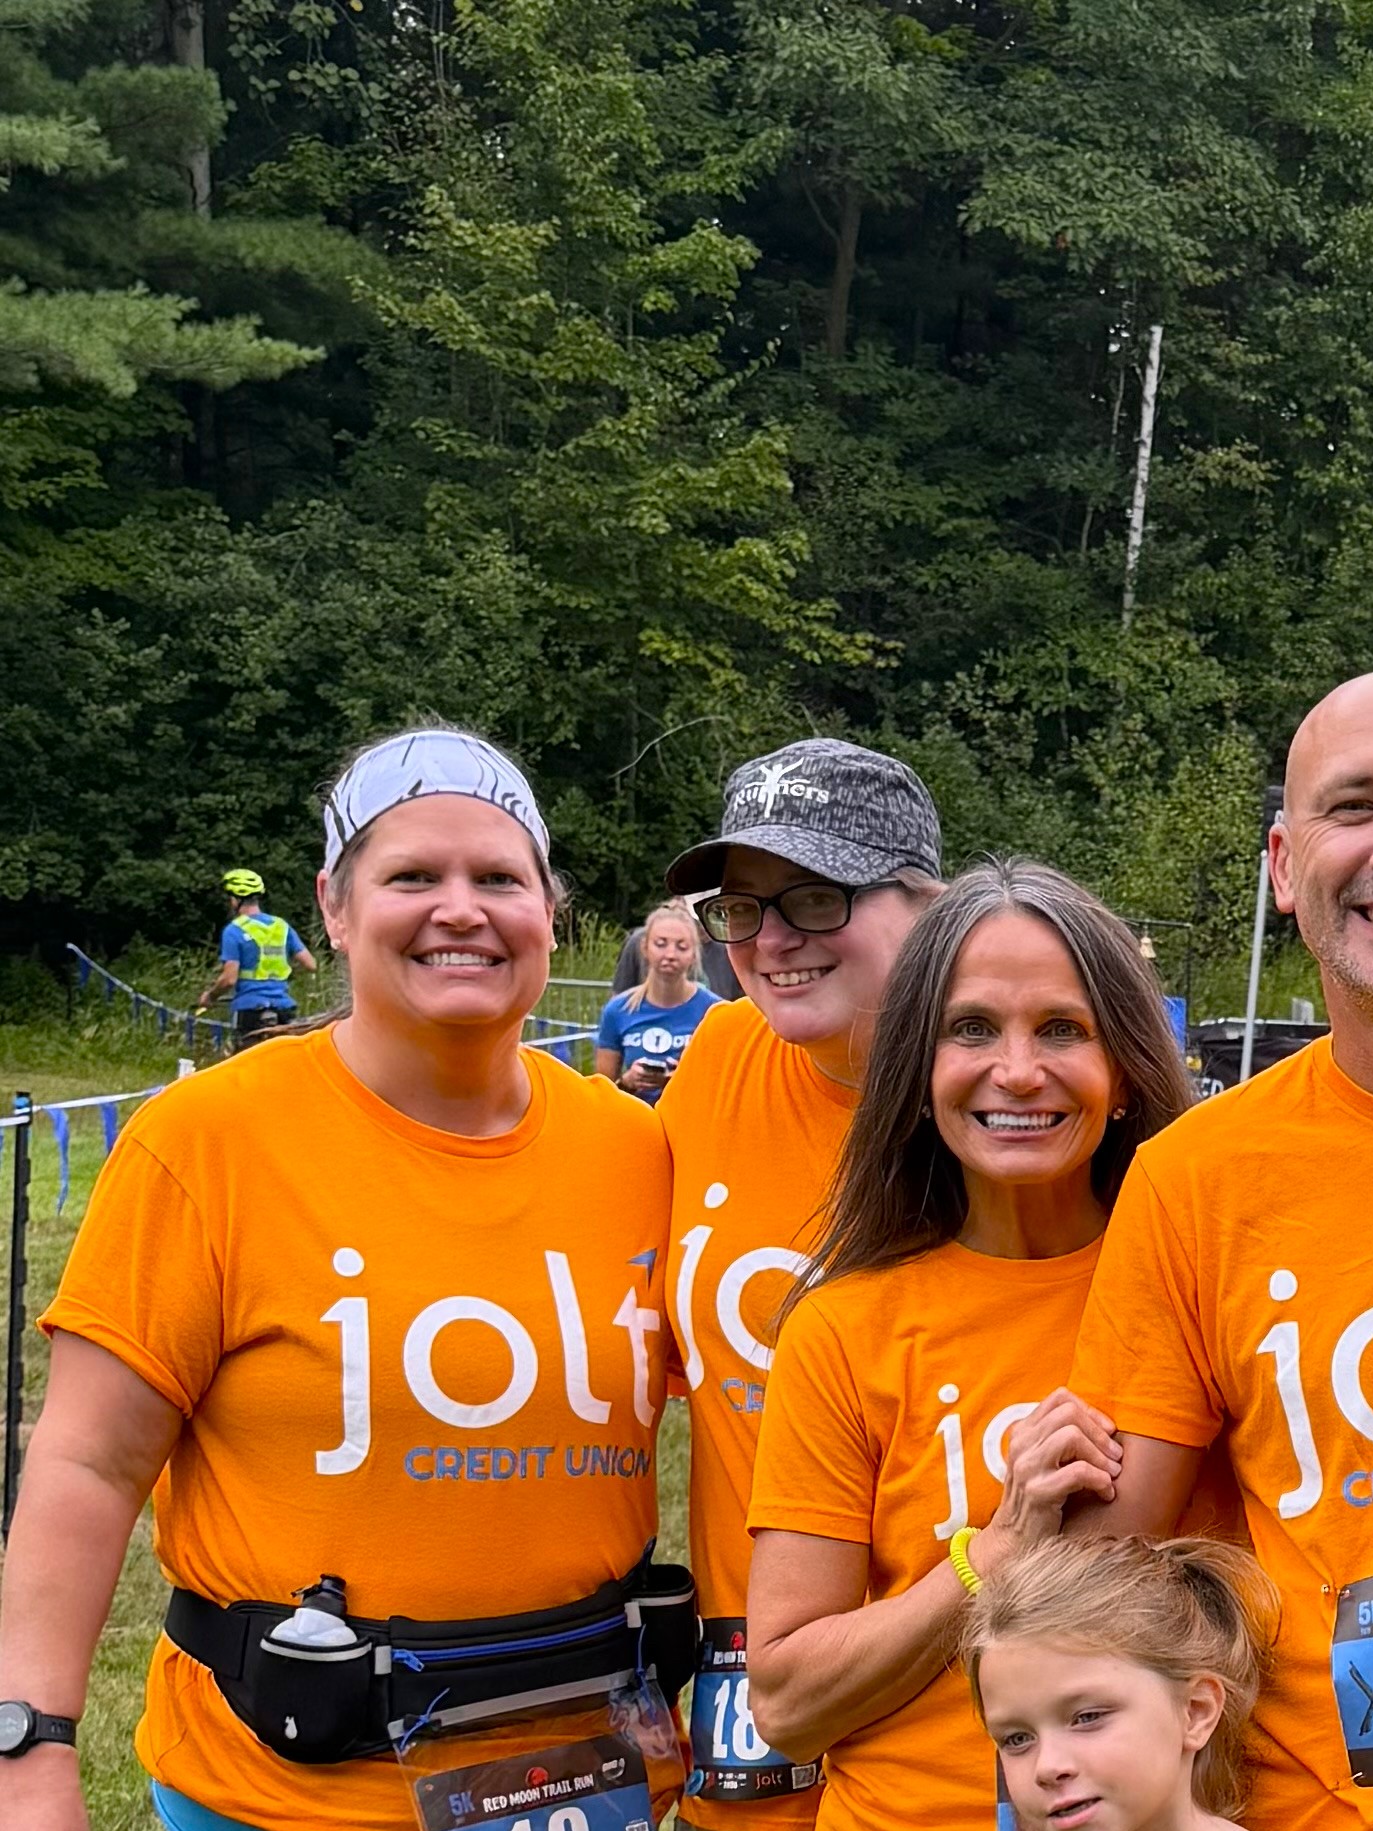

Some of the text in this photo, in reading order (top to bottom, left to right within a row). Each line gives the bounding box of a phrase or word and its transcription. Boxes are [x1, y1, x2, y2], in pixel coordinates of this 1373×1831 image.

[315, 1247, 661, 1476] jolt
[404, 1445, 652, 1481] CREDIT UNION
[712, 1678, 771, 1761] 18
[449, 1791, 475, 1816] 5K
[482, 1773, 594, 1813] RED MOON TRAIL RUN
